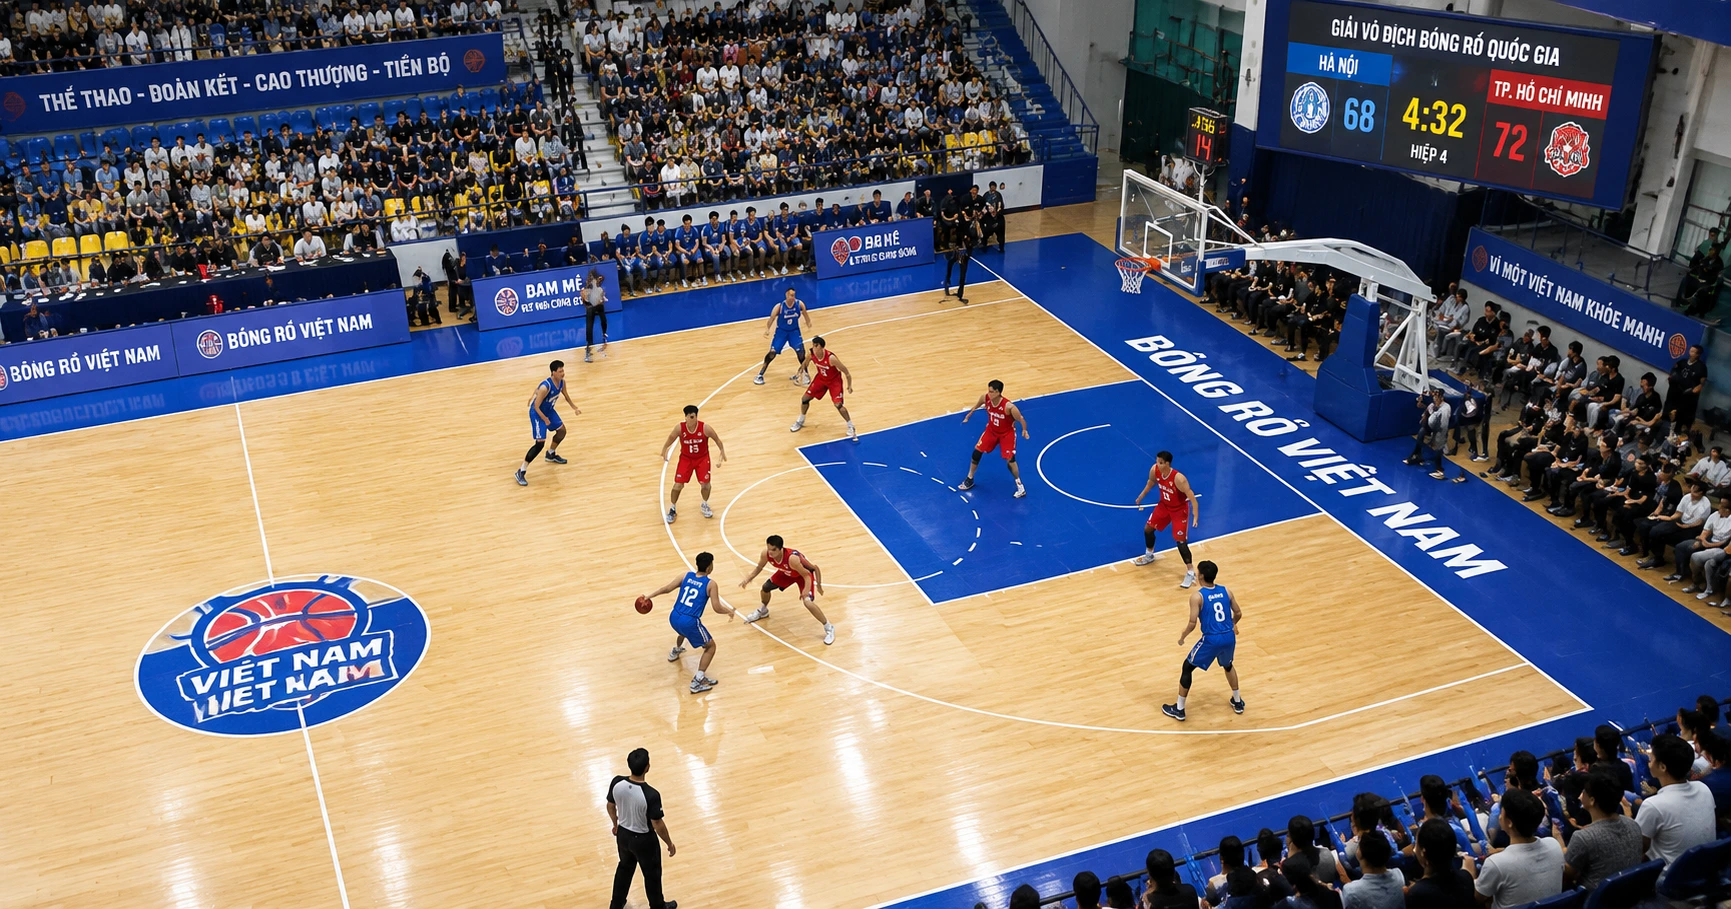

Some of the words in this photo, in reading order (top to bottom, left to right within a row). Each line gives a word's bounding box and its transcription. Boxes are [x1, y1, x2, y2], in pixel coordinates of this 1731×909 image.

[1419, 27, 1460, 52] BÓNG
[1533, 45, 1560, 67] GIA
[80, 87, 132, 109] THAO
[255, 71, 292, 92] CAO
[1494, 81, 1513, 99] TP.
[1538, 85, 1564, 106] CHÍ
[1343, 97, 1376, 133] 68
[1402, 97, 1467, 139] 4:32
[1195, 134, 1212, 160] 14
[1439, 149, 1448, 164] 4
[1493, 121, 1528, 162] 72
[1555, 285, 1585, 312] NAM
[227, 327, 271, 350] BÓNG
[337, 313, 373, 334] NAM
[125, 345, 162, 365] NAM
[1277, 437, 1397, 497] VIỆT
[1366, 501, 1508, 579] NAM
[680, 586, 699, 607] 12
[1213, 601, 1226, 622] 8
[293, 637, 383, 671] NAM
